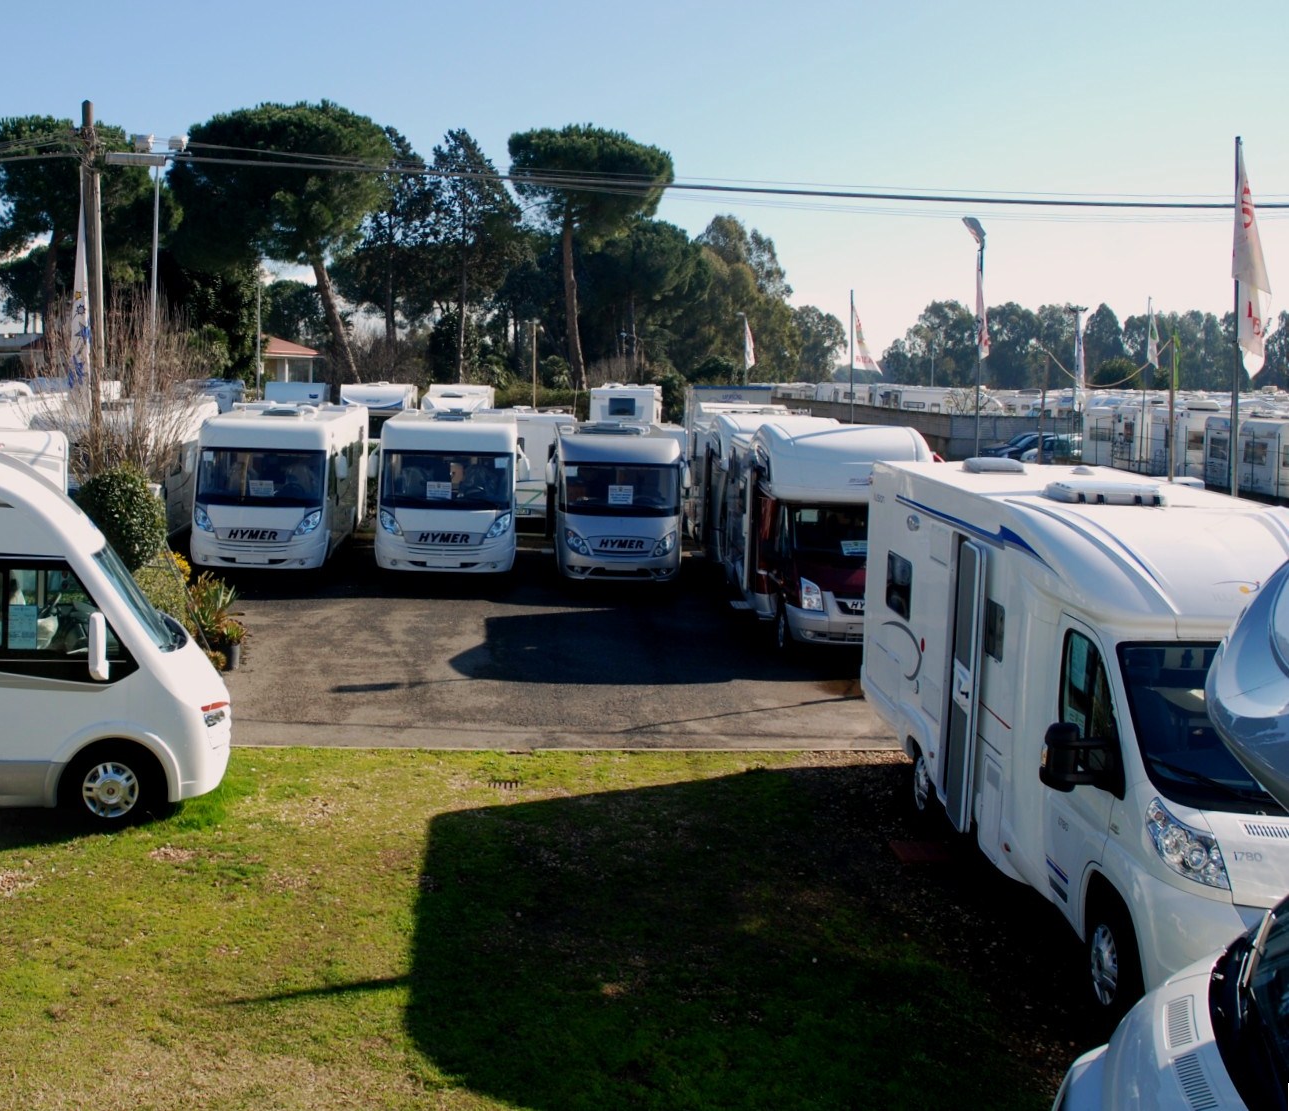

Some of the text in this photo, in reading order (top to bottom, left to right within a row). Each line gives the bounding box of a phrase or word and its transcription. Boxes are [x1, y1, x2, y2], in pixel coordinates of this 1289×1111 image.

[227, 529, 278, 541] HYMER
[418, 532, 471, 544] HYMER
[599, 538, 645, 550] HYMER
